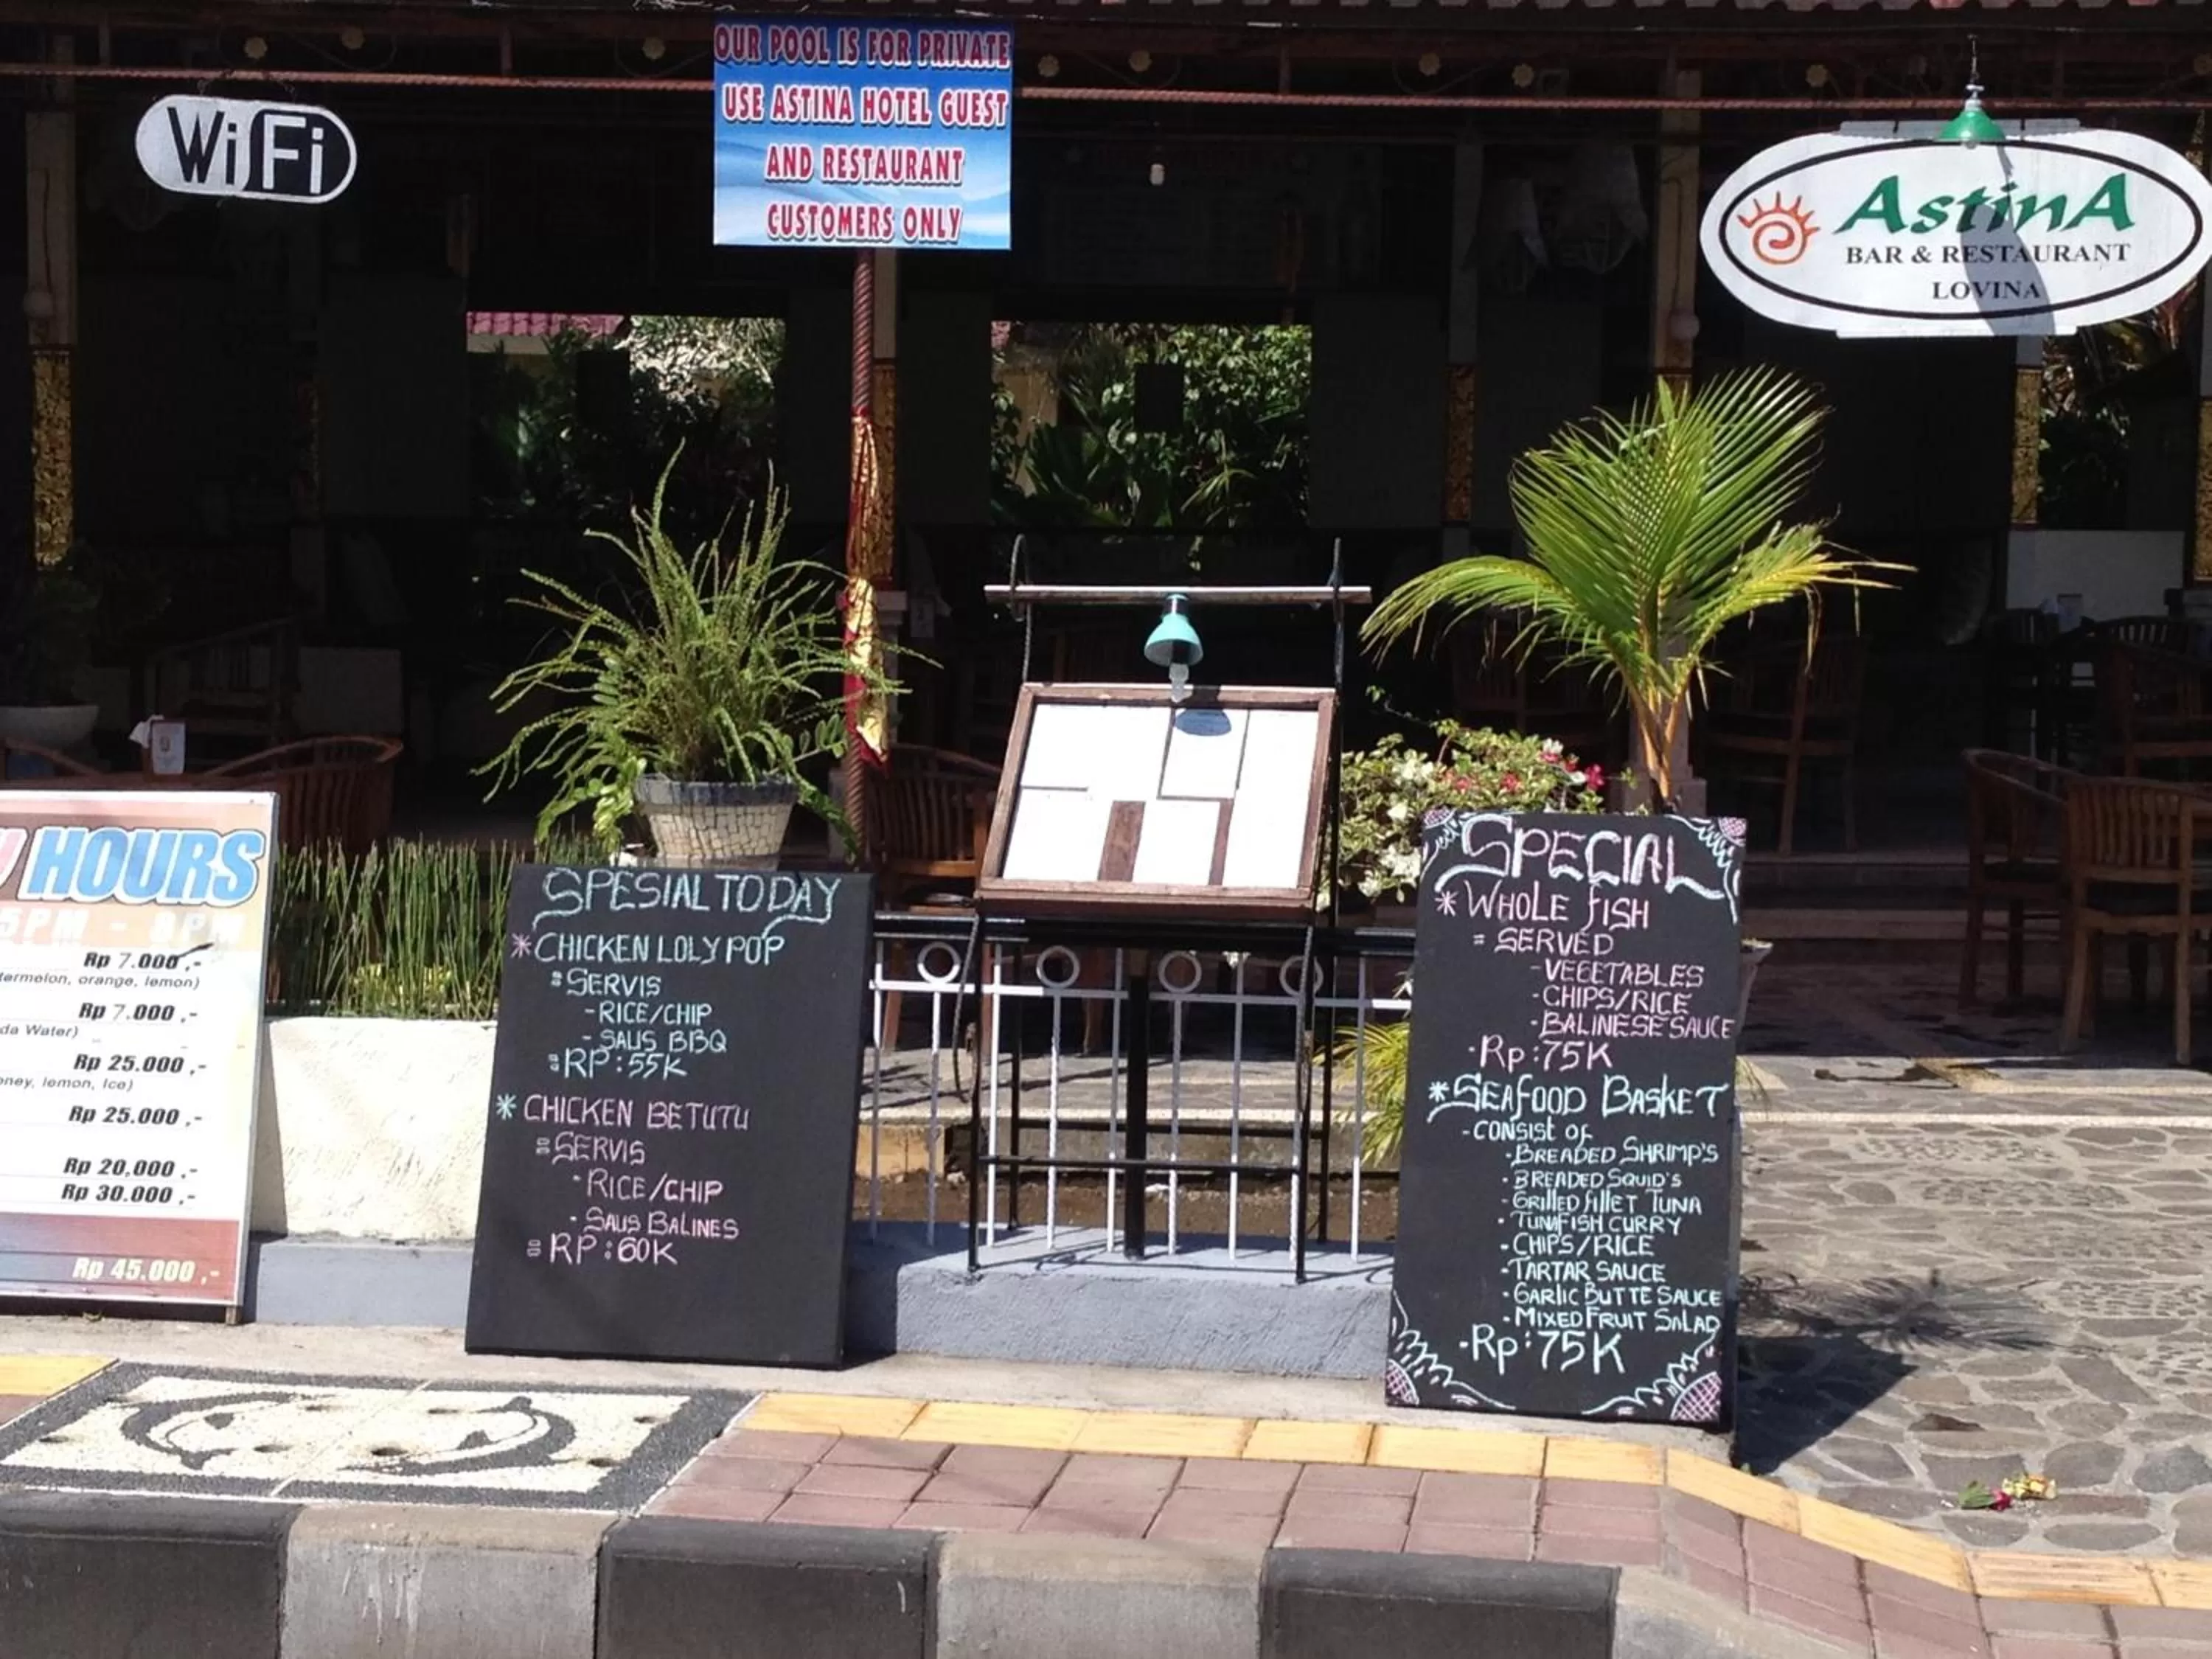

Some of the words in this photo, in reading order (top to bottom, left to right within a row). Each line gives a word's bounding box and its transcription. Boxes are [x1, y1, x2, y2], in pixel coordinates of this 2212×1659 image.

[714, 26, 761, 63] OUR
[768, 27, 830, 64] POOL
[837, 27, 859, 66] IS
[866, 29, 912, 67] FOR
[917, 30, 1011, 69] PRIVATE
[723, 83, 764, 120] USE
[770, 86, 854, 125] ASTINA
[860, 88, 931, 125] HOTEL
[939, 90, 1009, 127] GUEST
[765, 145, 814, 181] AND
[821, 146, 964, 185] RESTAURANT
[766, 203, 896, 241] CUSTOMERS
[902, 206, 962, 242] ONLY
[1846, 246, 1903, 264] BAR
[1911, 246, 1933, 264] &
[1941, 243, 2130, 264] RESTAURANT
[1933, 280, 2041, 300] LOVINA
[16, 827, 266, 908] HOURS
[1434, 813, 1725, 900] SPECIAL
[532, 867, 710, 931] SPESIAL
[715, 873, 841, 938] TODAY
[1464, 880, 1570, 922] WHOLE
[535, 931, 650, 963] CHICKEN
[1494, 928, 1614, 956] SERVED
[83, 952, 111, 970] Rp
[78, 974, 138, 989] orange,
[145, 975, 200, 990] lemon)
[566, 967, 662, 997] SERVIS
[1545, 959, 1705, 989] VEGETABLES
[78, 1002, 106, 1020] Rp
[26, 1024, 79, 1039] Water)
[1539, 1011, 1663, 1038] BALINESE
[1669, 1015, 1737, 1039] SAUCE
[599, 1029, 658, 1052] SAUS
[668, 1030, 728, 1054] BBQ
[73, 1054, 101, 1072] Rp
[42, 1077, 95, 1091] lemon,
[69, 1105, 96, 1124] Rp
[524, 1093, 633, 1128] CHICKEN
[647, 1101, 751, 1131] BETUTU
[552, 1131, 646, 1166] SERVIS
[1511, 1144, 1617, 1168] BREADED
[63, 1158, 91, 1176] Rp
[1514, 1169, 1604, 1189] BREADED
[61, 1183, 89, 1202] Rp
[1645, 1189, 1703, 1215] TUNA
[583, 1206, 642, 1235] SAUS
[647, 1211, 740, 1239] BALINES
[1608, 1216, 1682, 1236] CURRY
[72, 1257, 104, 1281] Rp
[1508, 1256, 1591, 1281] TARTAR
[1596, 1260, 1666, 1282] SAUCE
[1658, 1286, 1723, 1307] SAUCE
[1514, 1307, 1584, 1328] MIXED
[1586, 1307, 1647, 1331] FRUIT
